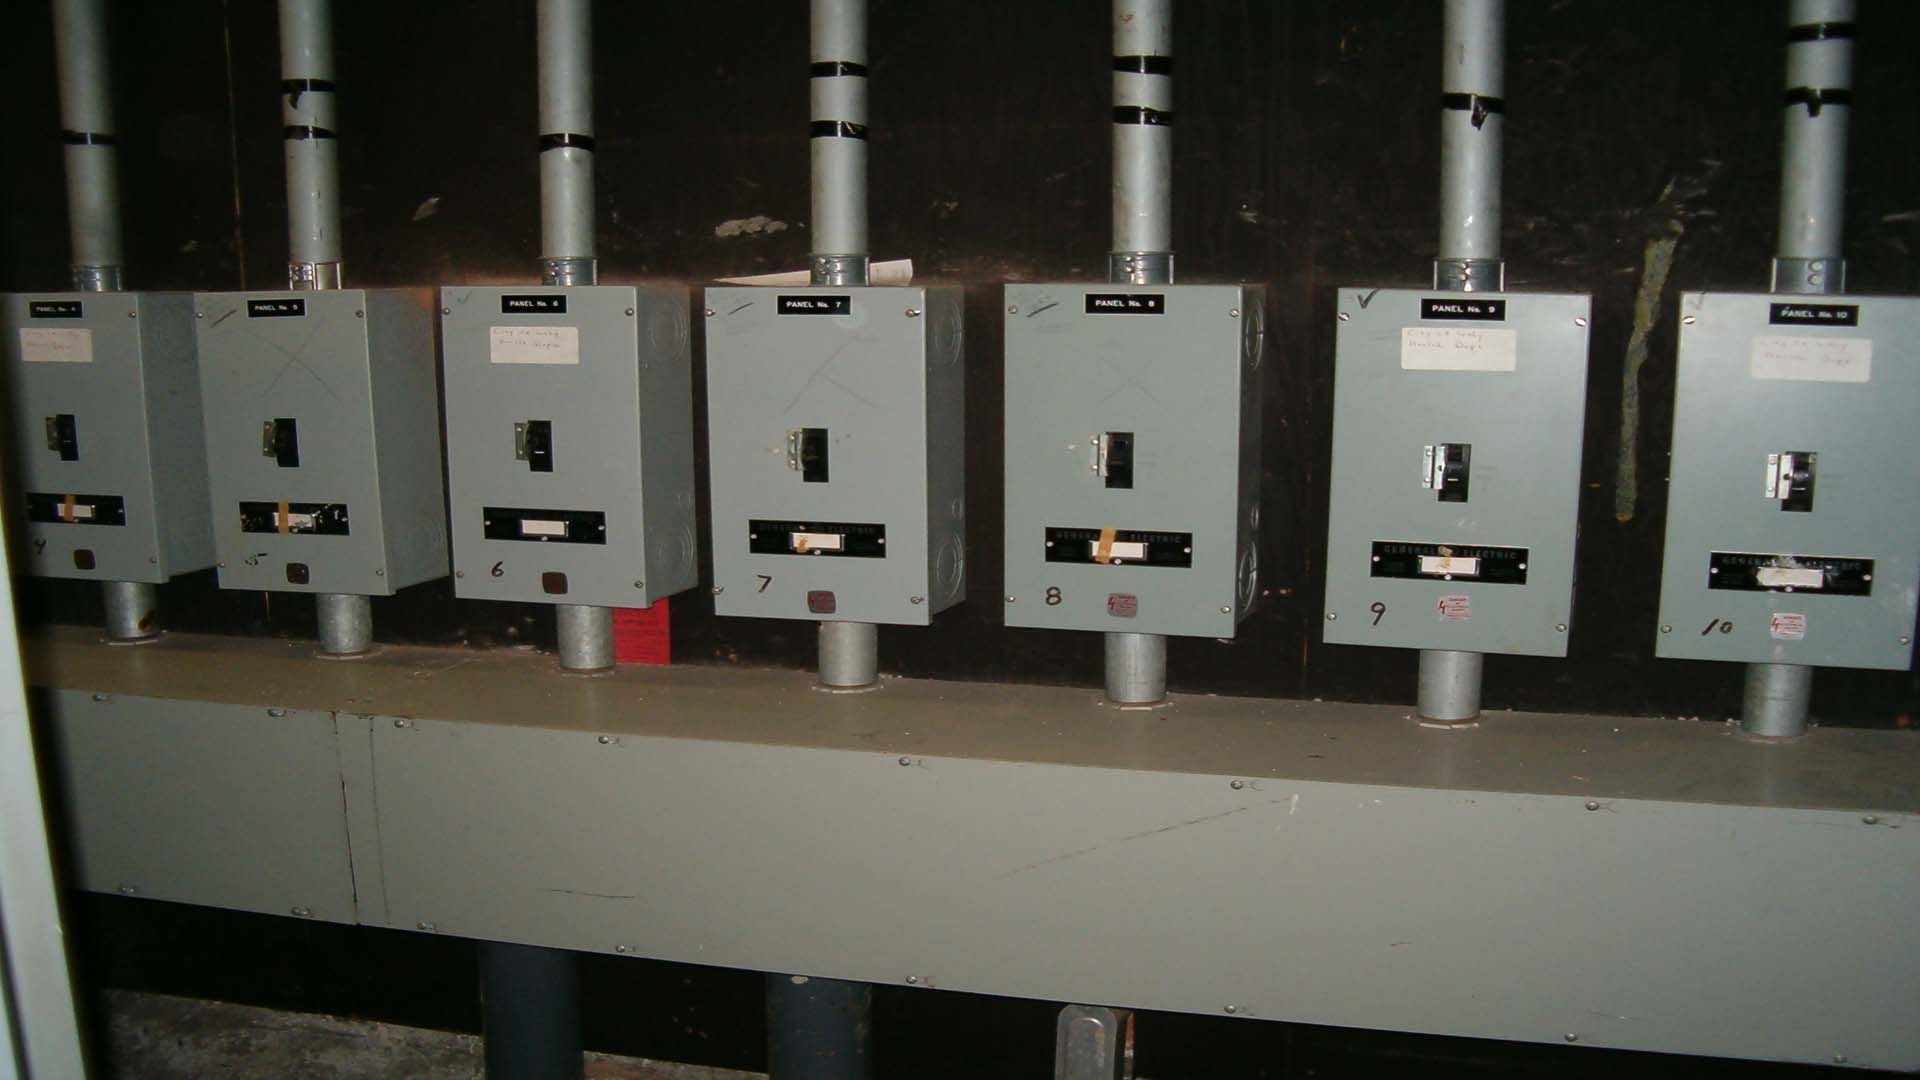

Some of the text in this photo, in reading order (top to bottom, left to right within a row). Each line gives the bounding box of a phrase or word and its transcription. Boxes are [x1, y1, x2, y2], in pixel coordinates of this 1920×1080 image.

[253, 303, 276, 311] PANEL
[509, 299, 535, 307] PANEL
[785, 300, 814, 308] PANEL
[1095, 299, 1125, 307] PANEL
[1147, 299, 1155, 308] 8
[1431, 304, 1464, 313] PANEL
[1488, 305, 1496, 314] 9
[1780, 308, 1815, 318] PANEL
[1836, 310, 1848, 319] 10
[244, 552, 269, 566] 5
[1383, 544, 1518, 560] GENERAL ELECTRIC
[491, 560, 505, 577] 6
[757, 574, 772, 593] 7
[1045, 586, 1062, 606] 8
[1370, 602, 1386, 626] 9
[1701, 618, 1733, 636] 10
